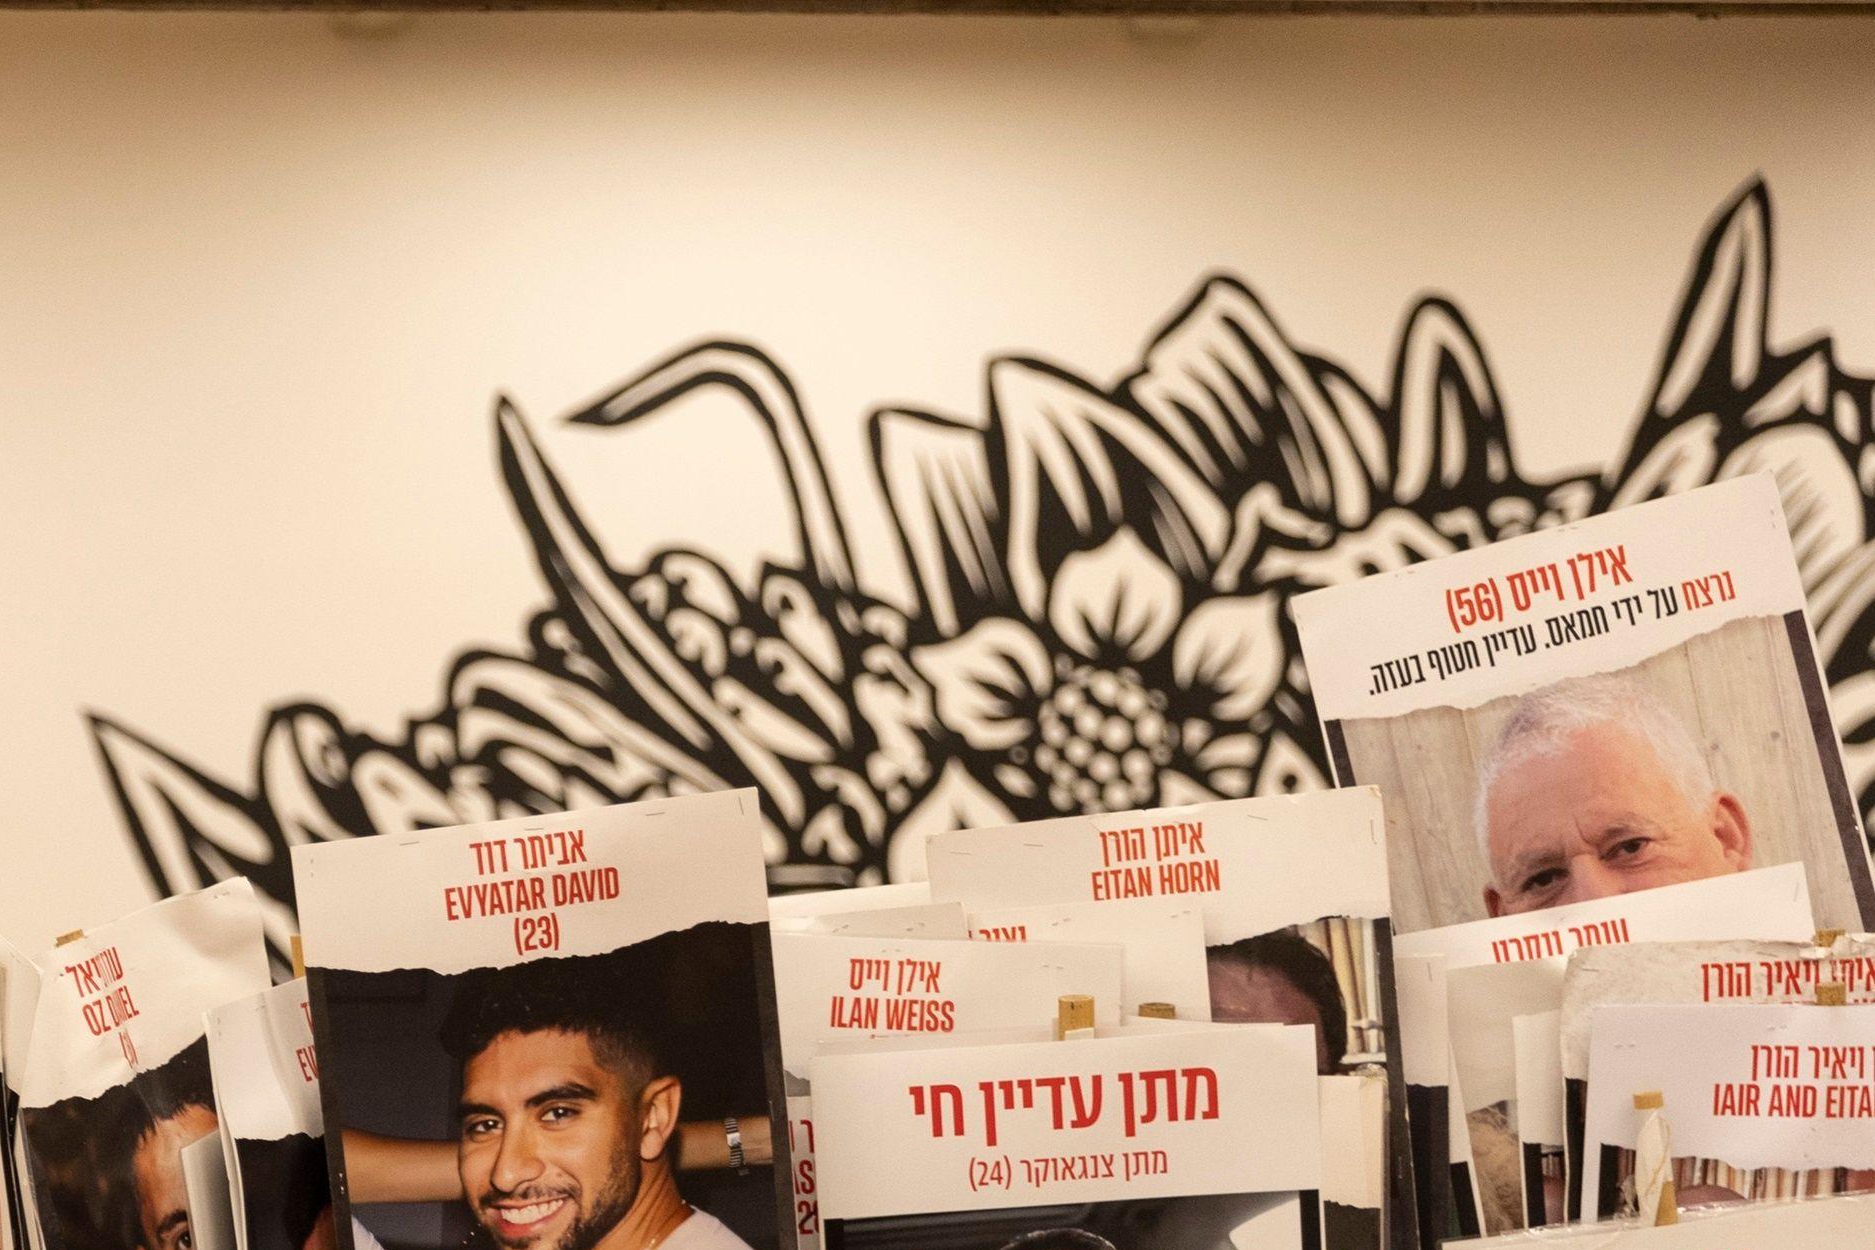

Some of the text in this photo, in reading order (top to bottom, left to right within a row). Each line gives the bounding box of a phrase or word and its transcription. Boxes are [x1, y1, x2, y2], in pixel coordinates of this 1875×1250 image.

[1445, 545, 1634, 633] אילן וייס (56)
[1646, 585, 1679, 619] על
[1681, 570, 1737, 611] נרצח
[1611, 596, 1643, 627] ידי
[1485, 622, 1539, 668] עדיין
[470, 829, 587, 877] אביתר דוד
[1099, 822, 1206, 869] איתן הורן
[444, 866, 621, 921] EVYATAR DAVID
[1091, 859, 1221, 901] EITAN HORN
[513, 912, 560, 956] (23)
[850, 957, 941, 994] אילן וייס
[1701, 961, 1752, 1003] הורן
[82, 999, 112, 1036] OZ
[830, 995, 955, 1034] ILAN WEISS
[1751, 1045, 1866, 1082] ויאיר הורן
[908, 1067, 1220, 1147] מתן עדיין חי
[1713, 1083, 1875, 1118] IAIR AND EITA
[968, 1155, 1013, 1193] (24)
[1121, 1149, 1169, 1187] מתן
